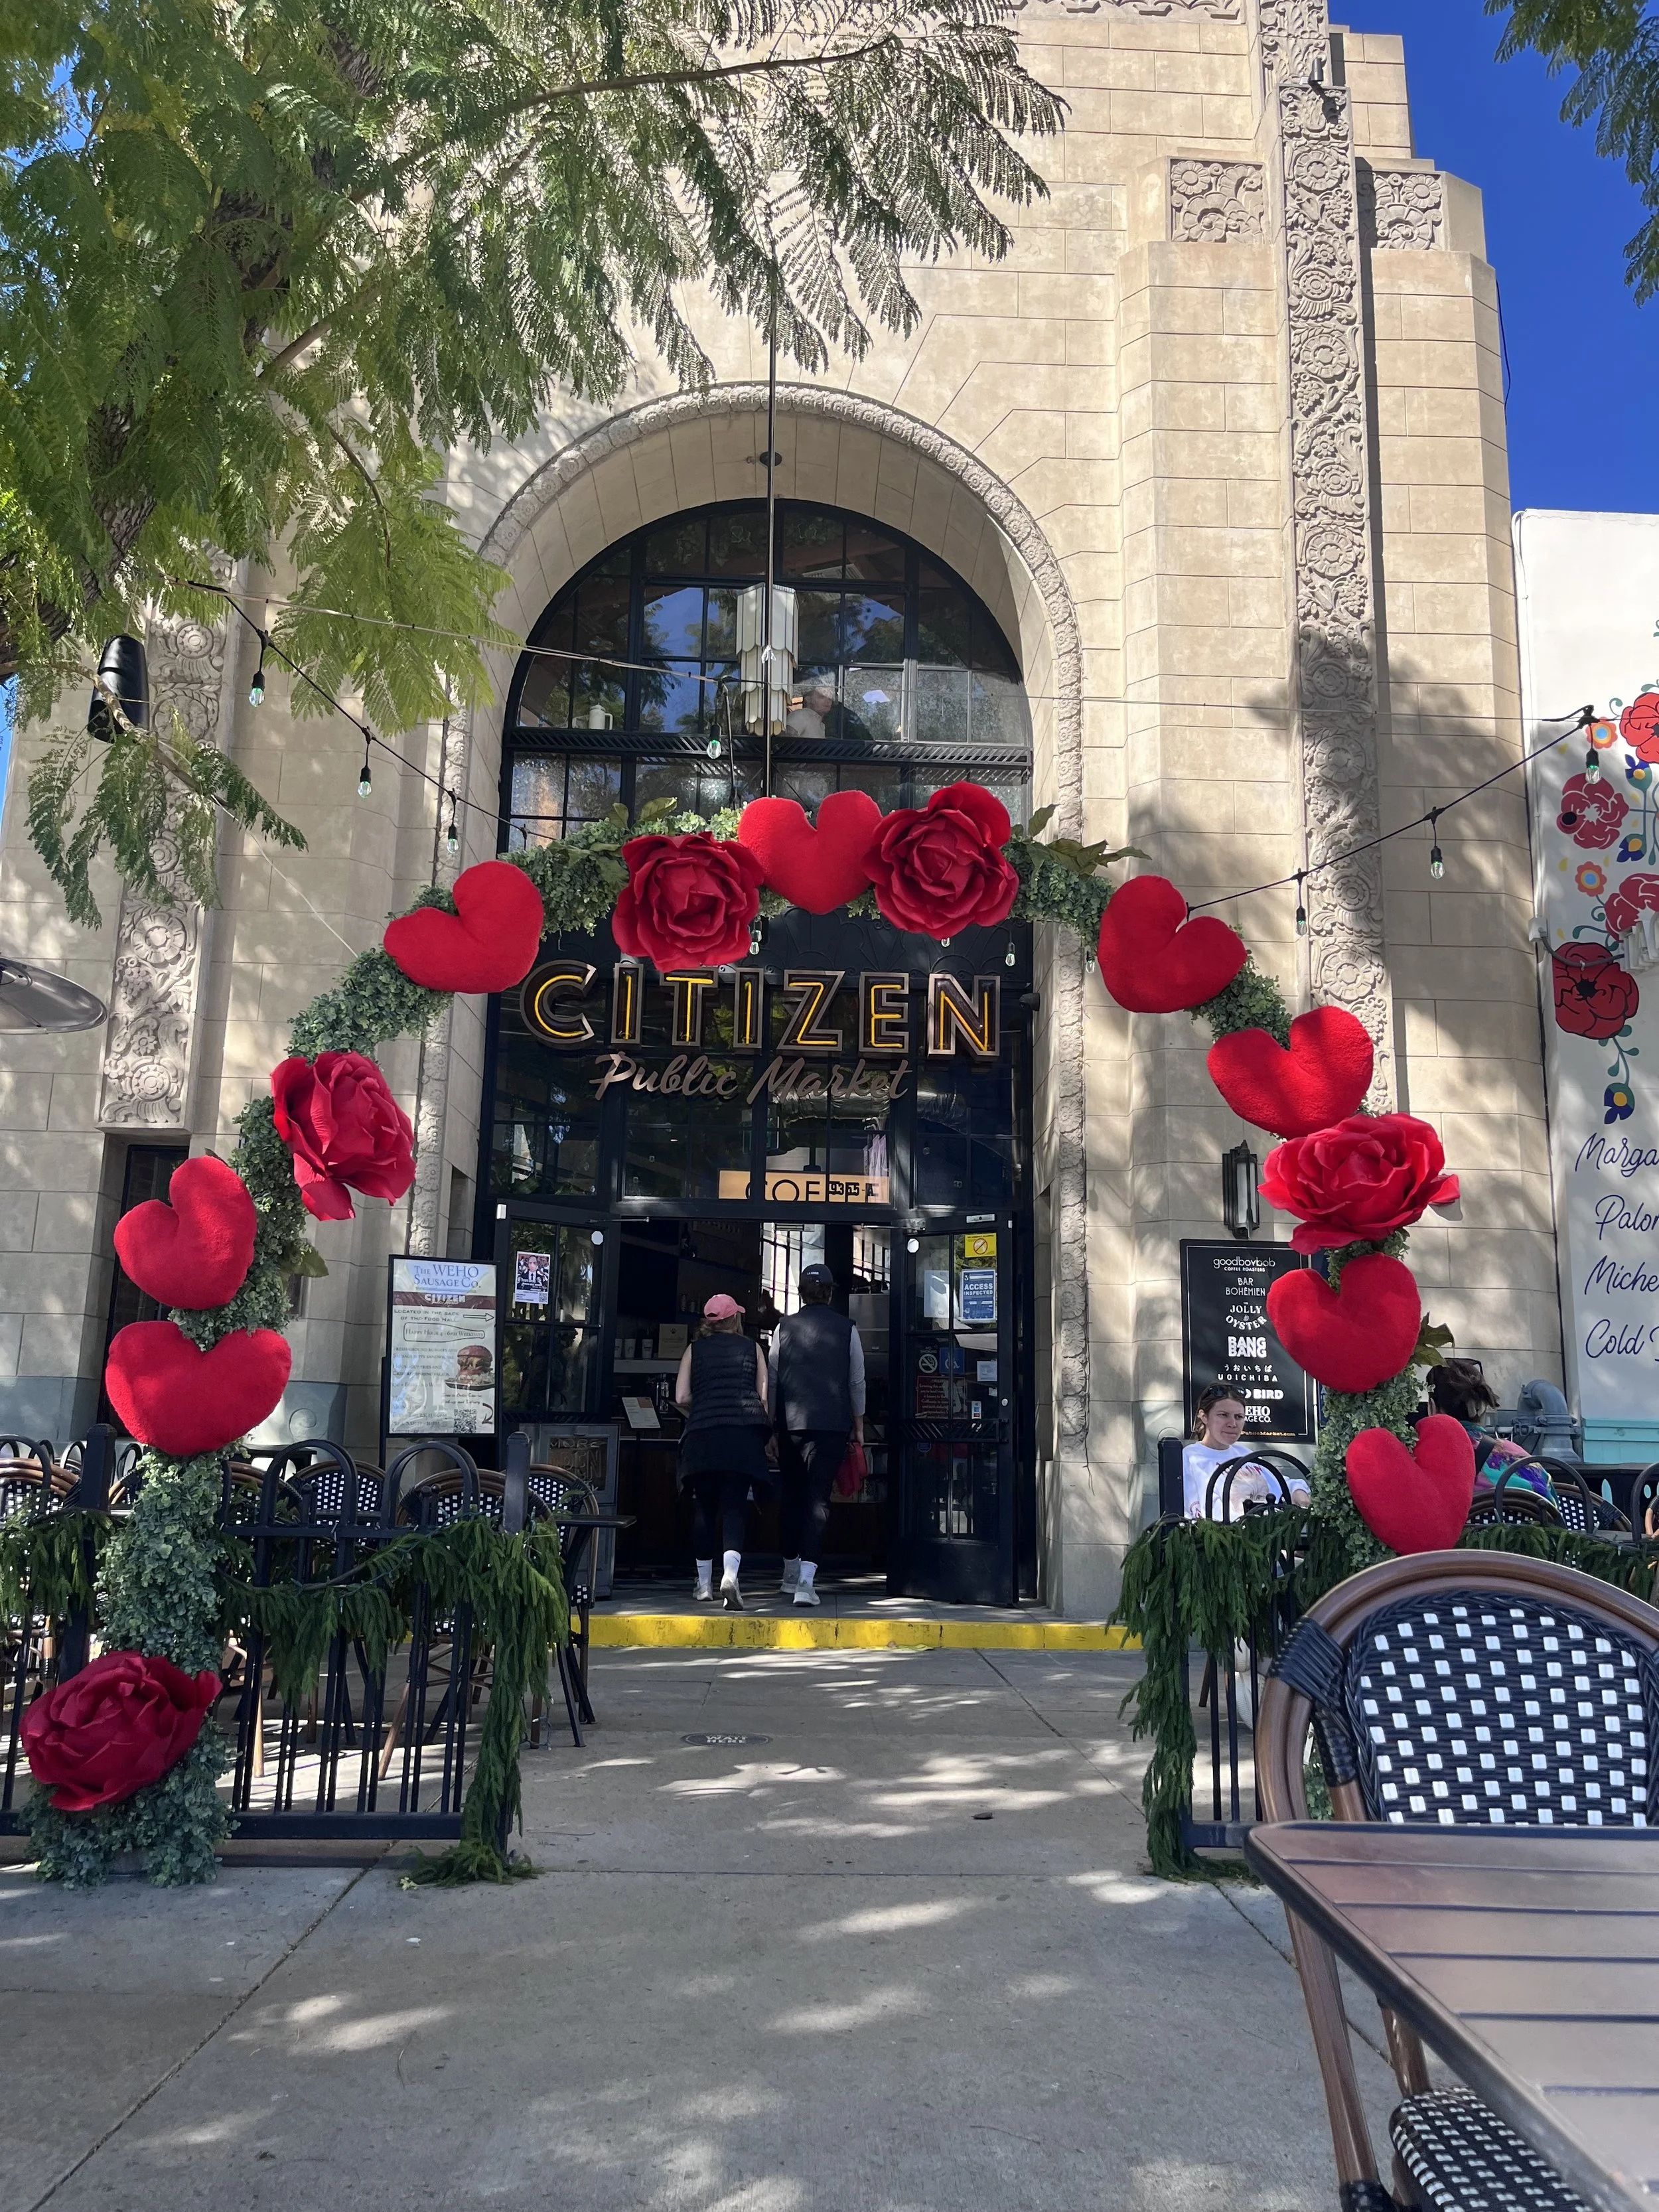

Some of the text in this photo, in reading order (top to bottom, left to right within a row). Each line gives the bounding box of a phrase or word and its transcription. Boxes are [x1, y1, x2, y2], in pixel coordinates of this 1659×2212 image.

[519, 959, 1001, 1057] CITIZEN
[589, 1051, 914, 1106] Public Market
[433, 1264, 479, 1278] WEHO
[1237, 1277, 1254, 1286] BAR
[425, 1293, 466, 1303] CITIZEN
[1230, 1305, 1262, 1314] JOLLY
[1226, 1315, 1267, 1331] OYSTER
[1228, 1336, 1266, 1349] BANG
[1585, 1318, 1644, 1359] Cold
[1228, 1347, 1267, 1358] BANG
[1218, 1373, 1278, 1382] UOICHIBA
[1253, 1388, 1284, 1400] BIRD
[1245, 1406, 1271, 1416] EHO
